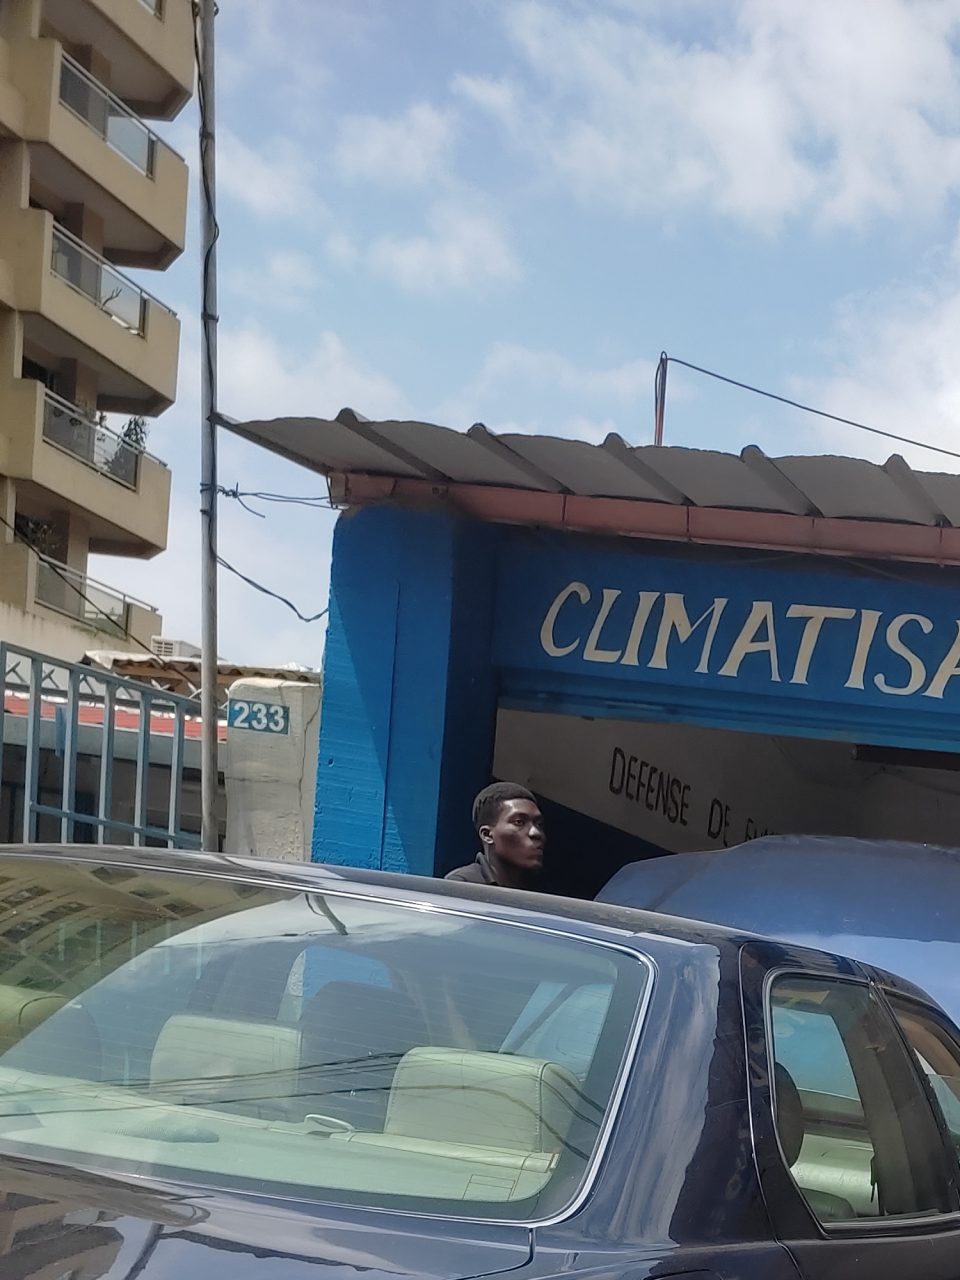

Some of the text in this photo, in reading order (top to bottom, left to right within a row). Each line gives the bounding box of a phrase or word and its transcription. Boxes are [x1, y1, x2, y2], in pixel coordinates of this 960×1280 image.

[233, 701, 285, 732] 233
[609, 747, 731, 848] DEFENSE DE
